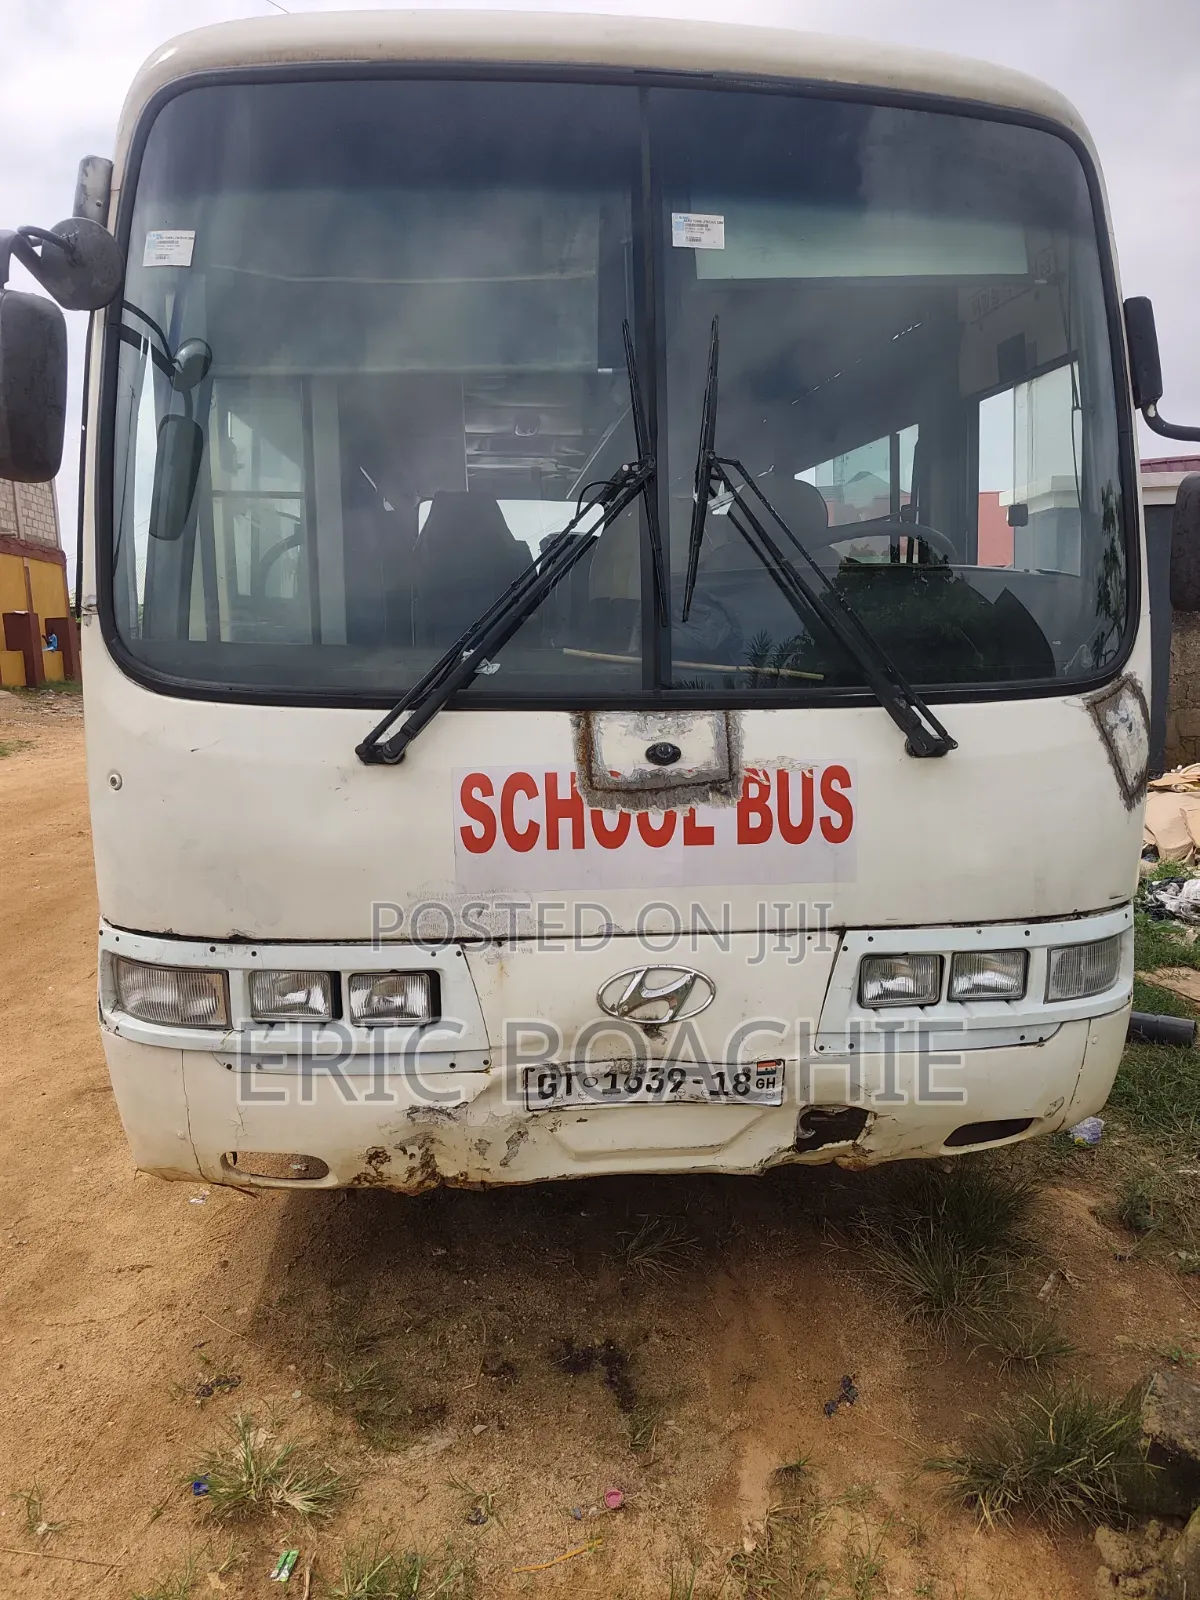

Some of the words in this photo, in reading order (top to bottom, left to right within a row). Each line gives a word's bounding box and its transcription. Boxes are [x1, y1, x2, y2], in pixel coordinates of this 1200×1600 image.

[736, 764, 854, 845] BUS
[537, 1071, 582, 1100] GT
[755, 1077, 777, 1090] GH
